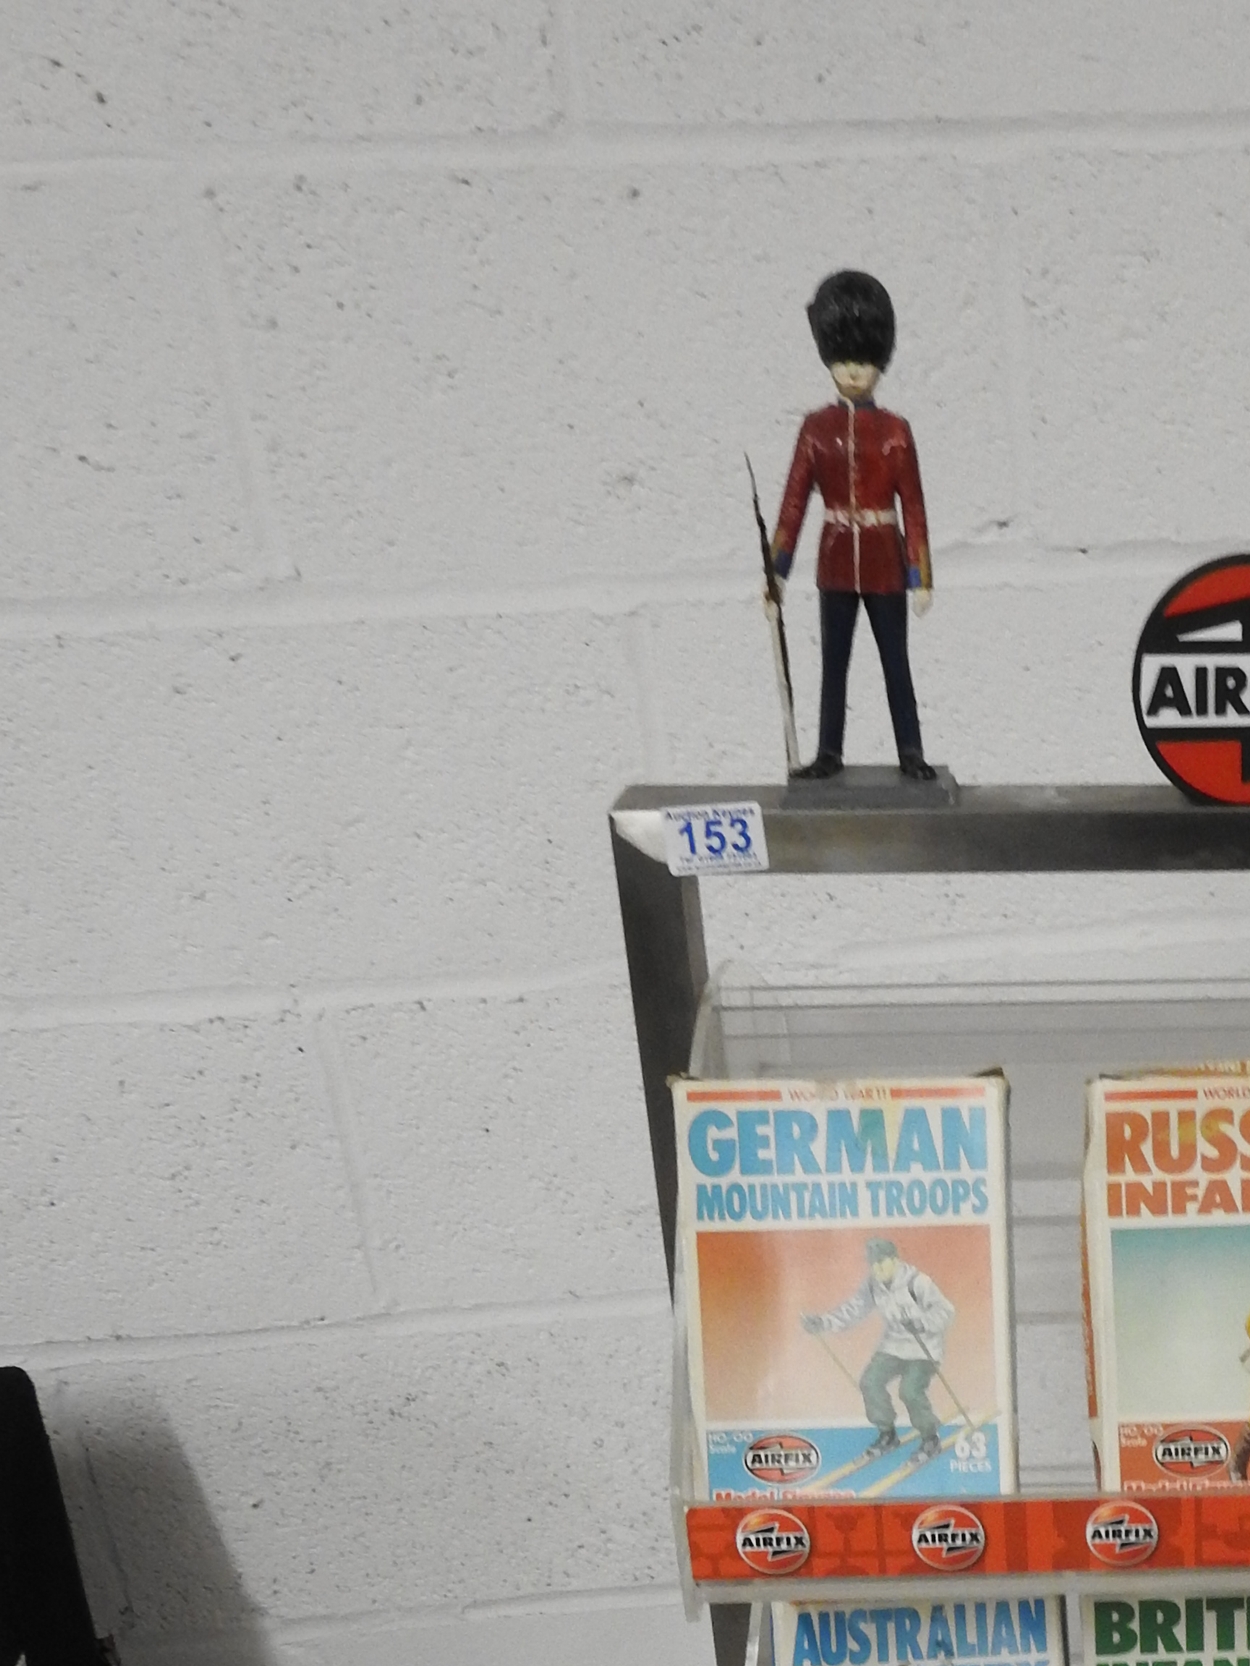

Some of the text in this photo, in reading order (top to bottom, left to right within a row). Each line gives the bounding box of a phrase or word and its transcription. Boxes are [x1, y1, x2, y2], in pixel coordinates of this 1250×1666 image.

[679, 818, 752, 855] 153
[688, 1106, 988, 1177] GERMAN
[696, 1177, 989, 1222] MOUNTAIN TROOPS
[954, 1430, 987, 1459] 63
[1161, 1446, 1222, 1458] AIRFIX
[750, 1452, 813, 1467] AIRFIX
[950, 1459, 992, 1473] PIECES
[916, 1532, 982, 1545] AIRFIX
[1090, 1527, 1154, 1541] AIRFIX
[741, 1535, 807, 1549] AIRFIX
